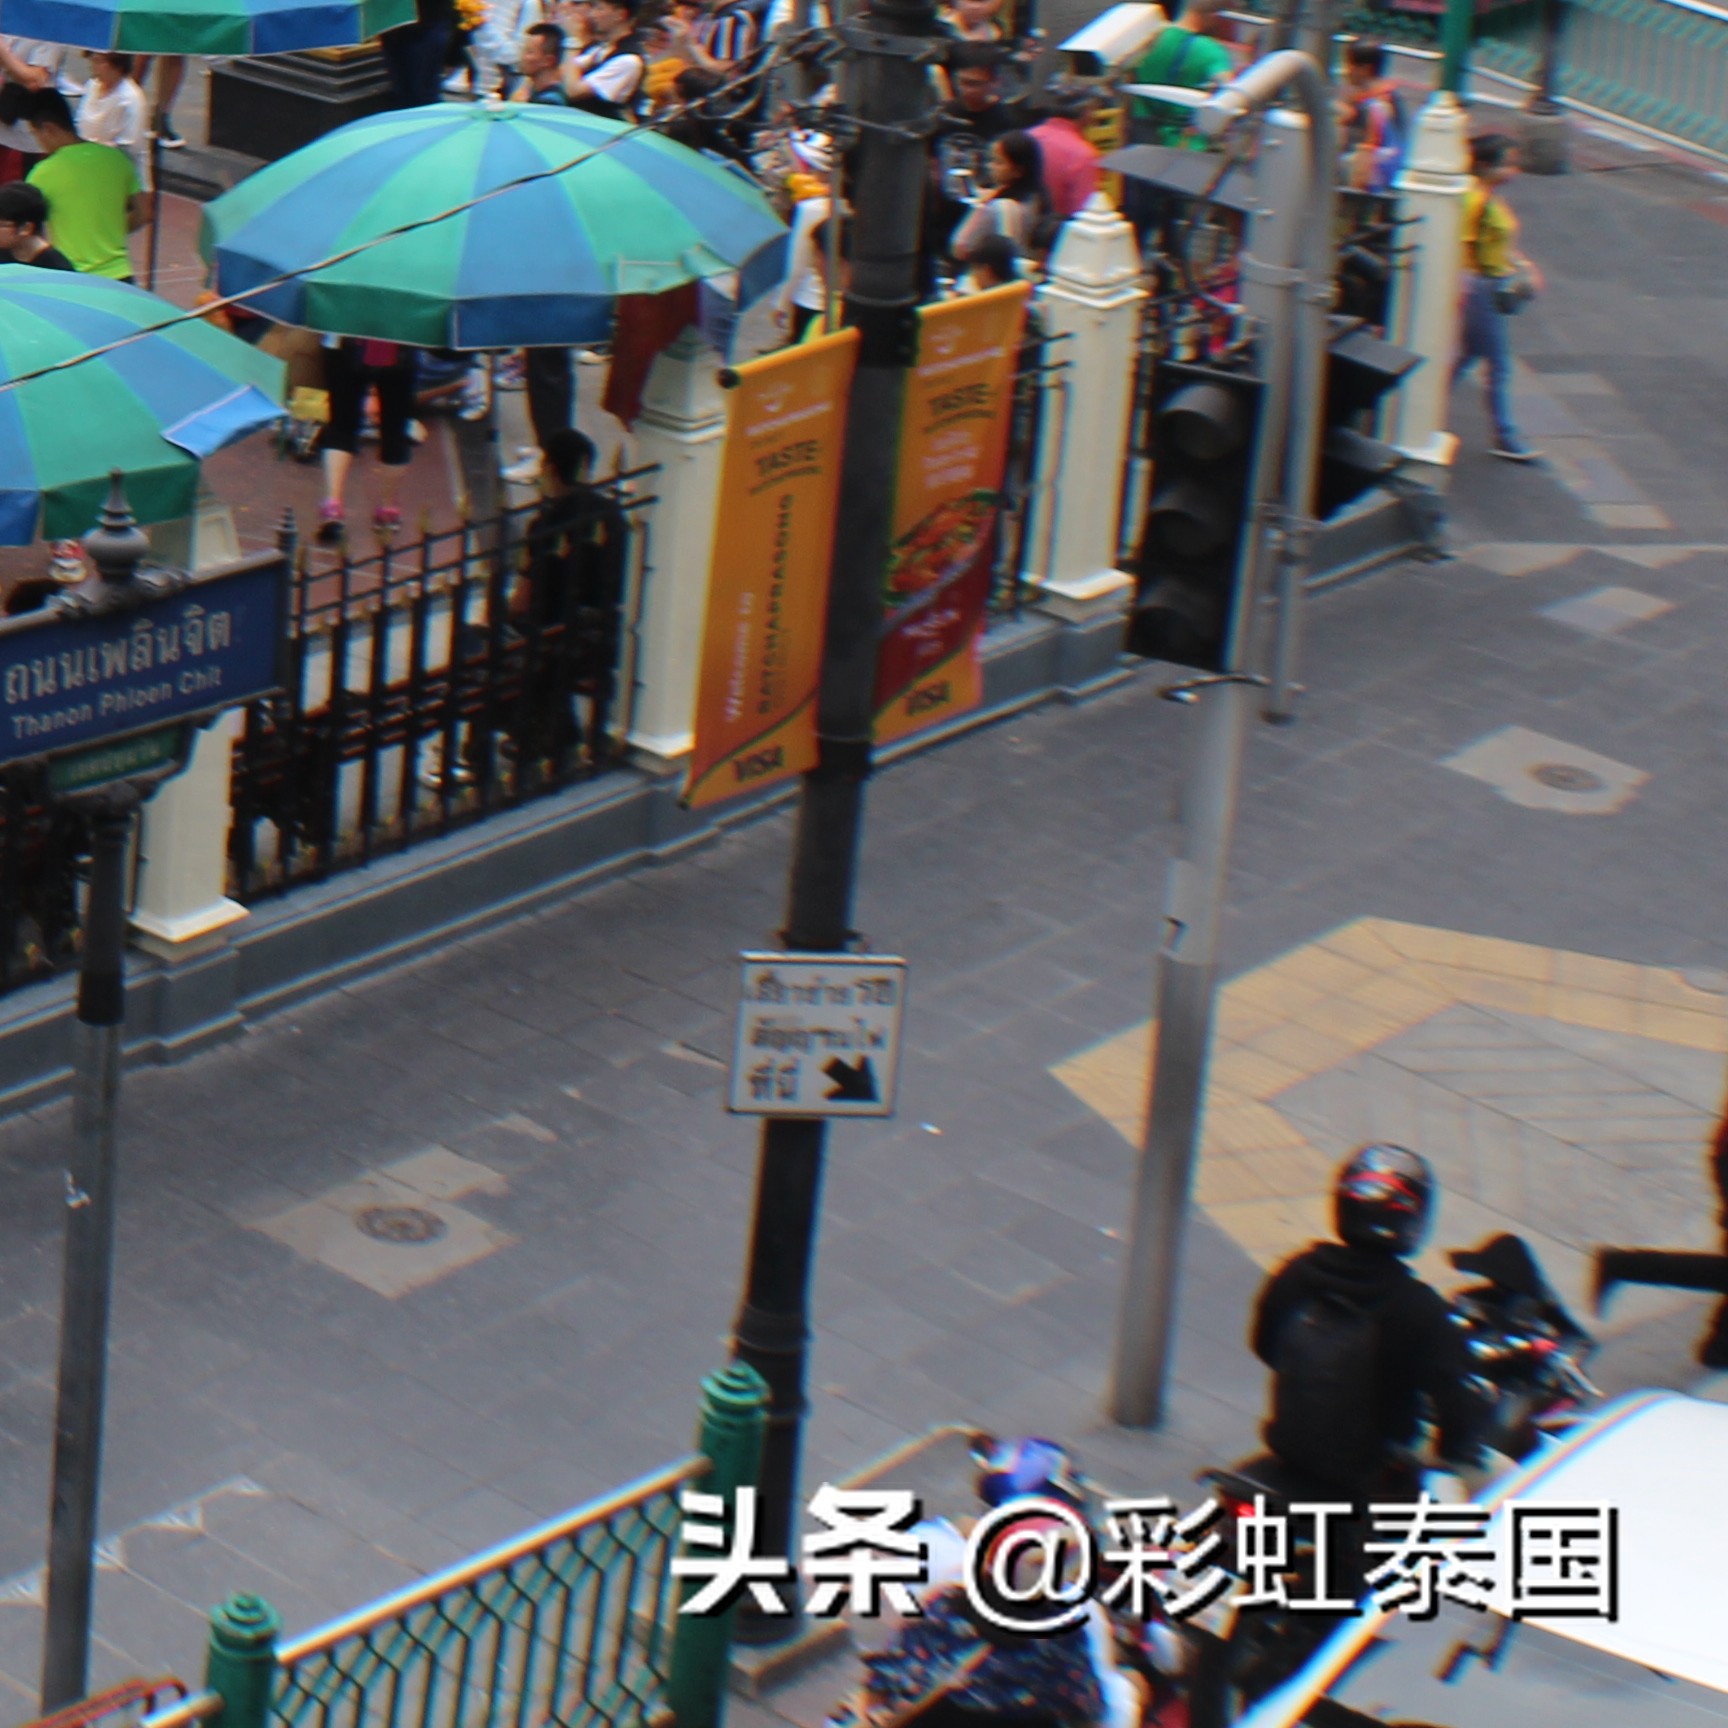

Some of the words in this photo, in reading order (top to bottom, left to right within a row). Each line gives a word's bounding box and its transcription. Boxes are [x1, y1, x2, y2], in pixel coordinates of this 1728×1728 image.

[4, 603, 232, 705] ถนนเพลินจิต
[11, 703, 93, 739] Thanon
[98, 683, 173, 717] Phloen
[178, 666, 223, 696] Chit
